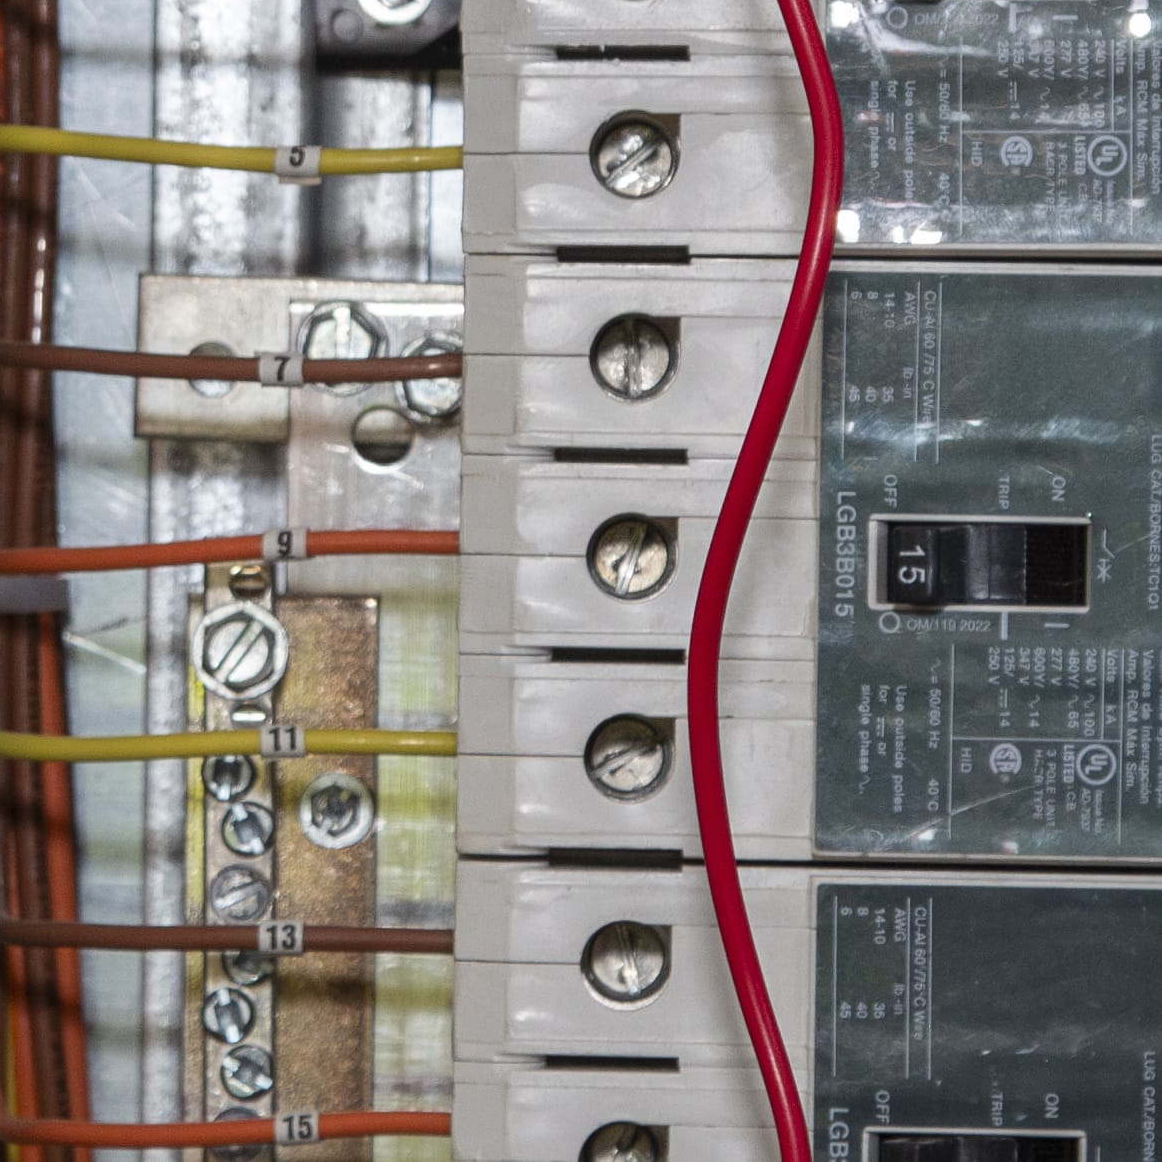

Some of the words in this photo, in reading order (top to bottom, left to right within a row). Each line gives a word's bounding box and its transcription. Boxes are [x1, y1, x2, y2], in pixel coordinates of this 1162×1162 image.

[1115, 40, 1127, 74] Volts
[887, 80, 899, 98] for
[904, 80, 916, 106] Use
[904, 112, 916, 164] outside
[938, 125, 951, 143] Hz
[867, 127, 881, 168] phase
[971, 141, 983, 167] HID
[1074, 136, 1086, 175] LISTED
[883, 292, 896, 329] 14-10
[903, 291, 915, 326] AWG
[273, 356, 287, 382] 7
[848, 385, 861, 403] 45
[864, 386, 877, 403] 40
[882, 386, 894, 403] 35
[1150, 434, 1161, 464] LUG
[884, 474, 898, 508] OFF
[998, 477, 1010, 510] TRIP
[1051, 476, 1065, 502] ON
[276, 530, 292, 556] 9
[835, 490, 855, 617] LGB3B015
[898, 544, 925, 585] 15
[988, 646, 1000, 670] 250
[1019, 647, 1030, 671] 347
[1051, 648, 1062, 671] 277
[1068, 648, 1079, 689] 480Y/
[1085, 648, 1097, 672] 240
[1106, 649, 1118, 683] Volts
[1125, 649, 1139, 684] Amp.
[988, 676, 1000, 685] V
[1019, 676, 1030, 686] V
[1051, 677, 1062, 687] V
[1085, 677, 1097, 687] V
[1141, 649, 1154, 697] Valores
[857, 684, 872, 725] single
[878, 684, 890, 703] for
[894, 685, 907, 712] Use
[1126, 690, 1138, 722] RCM
[999, 711, 1010, 728] 14
[1028, 711, 1040, 728] 14
[1067, 711, 1079, 729] 65
[1084, 711, 1095, 737] 100
[1141, 703, 1154, 720] de
[269, 726, 297, 753] 11
[857, 731, 872, 773] phase
[878, 742, 890, 756] or
[894, 717, 907, 769] outside
[928, 731, 941, 749] Hz
[1125, 728, 1139, 757] Máx
[960, 747, 972, 773] HID
[1046, 749, 1056, 757] 3
[1063, 744, 1075, 783] LISTED
[1046, 762, 1056, 795] POLE
[1125, 762, 1138, 791] Sim.
[891, 775, 905, 813] poles
[1033, 789, 1044, 820] TYPE
[839, 906, 851, 916] 6
[856, 906, 868, 916] 8
[266, 924, 298, 950] 13
[874, 908, 885, 945] 14-10
[893, 908, 905, 943] AWG
[838, 1001, 851, 1019] 45
[856, 1002, 867, 1019] 40
[873, 1002, 885, 1019] 35
[1142, 1051, 1156, 1081] LUG
[875, 1090, 890, 1124] OFF
[991, 1092, 1003, 1126] TRIP
[1044, 1093, 1059, 1119] ON
[282, 1114, 315, 1141] 15
[829, 1106, 849, 1162] LGB
